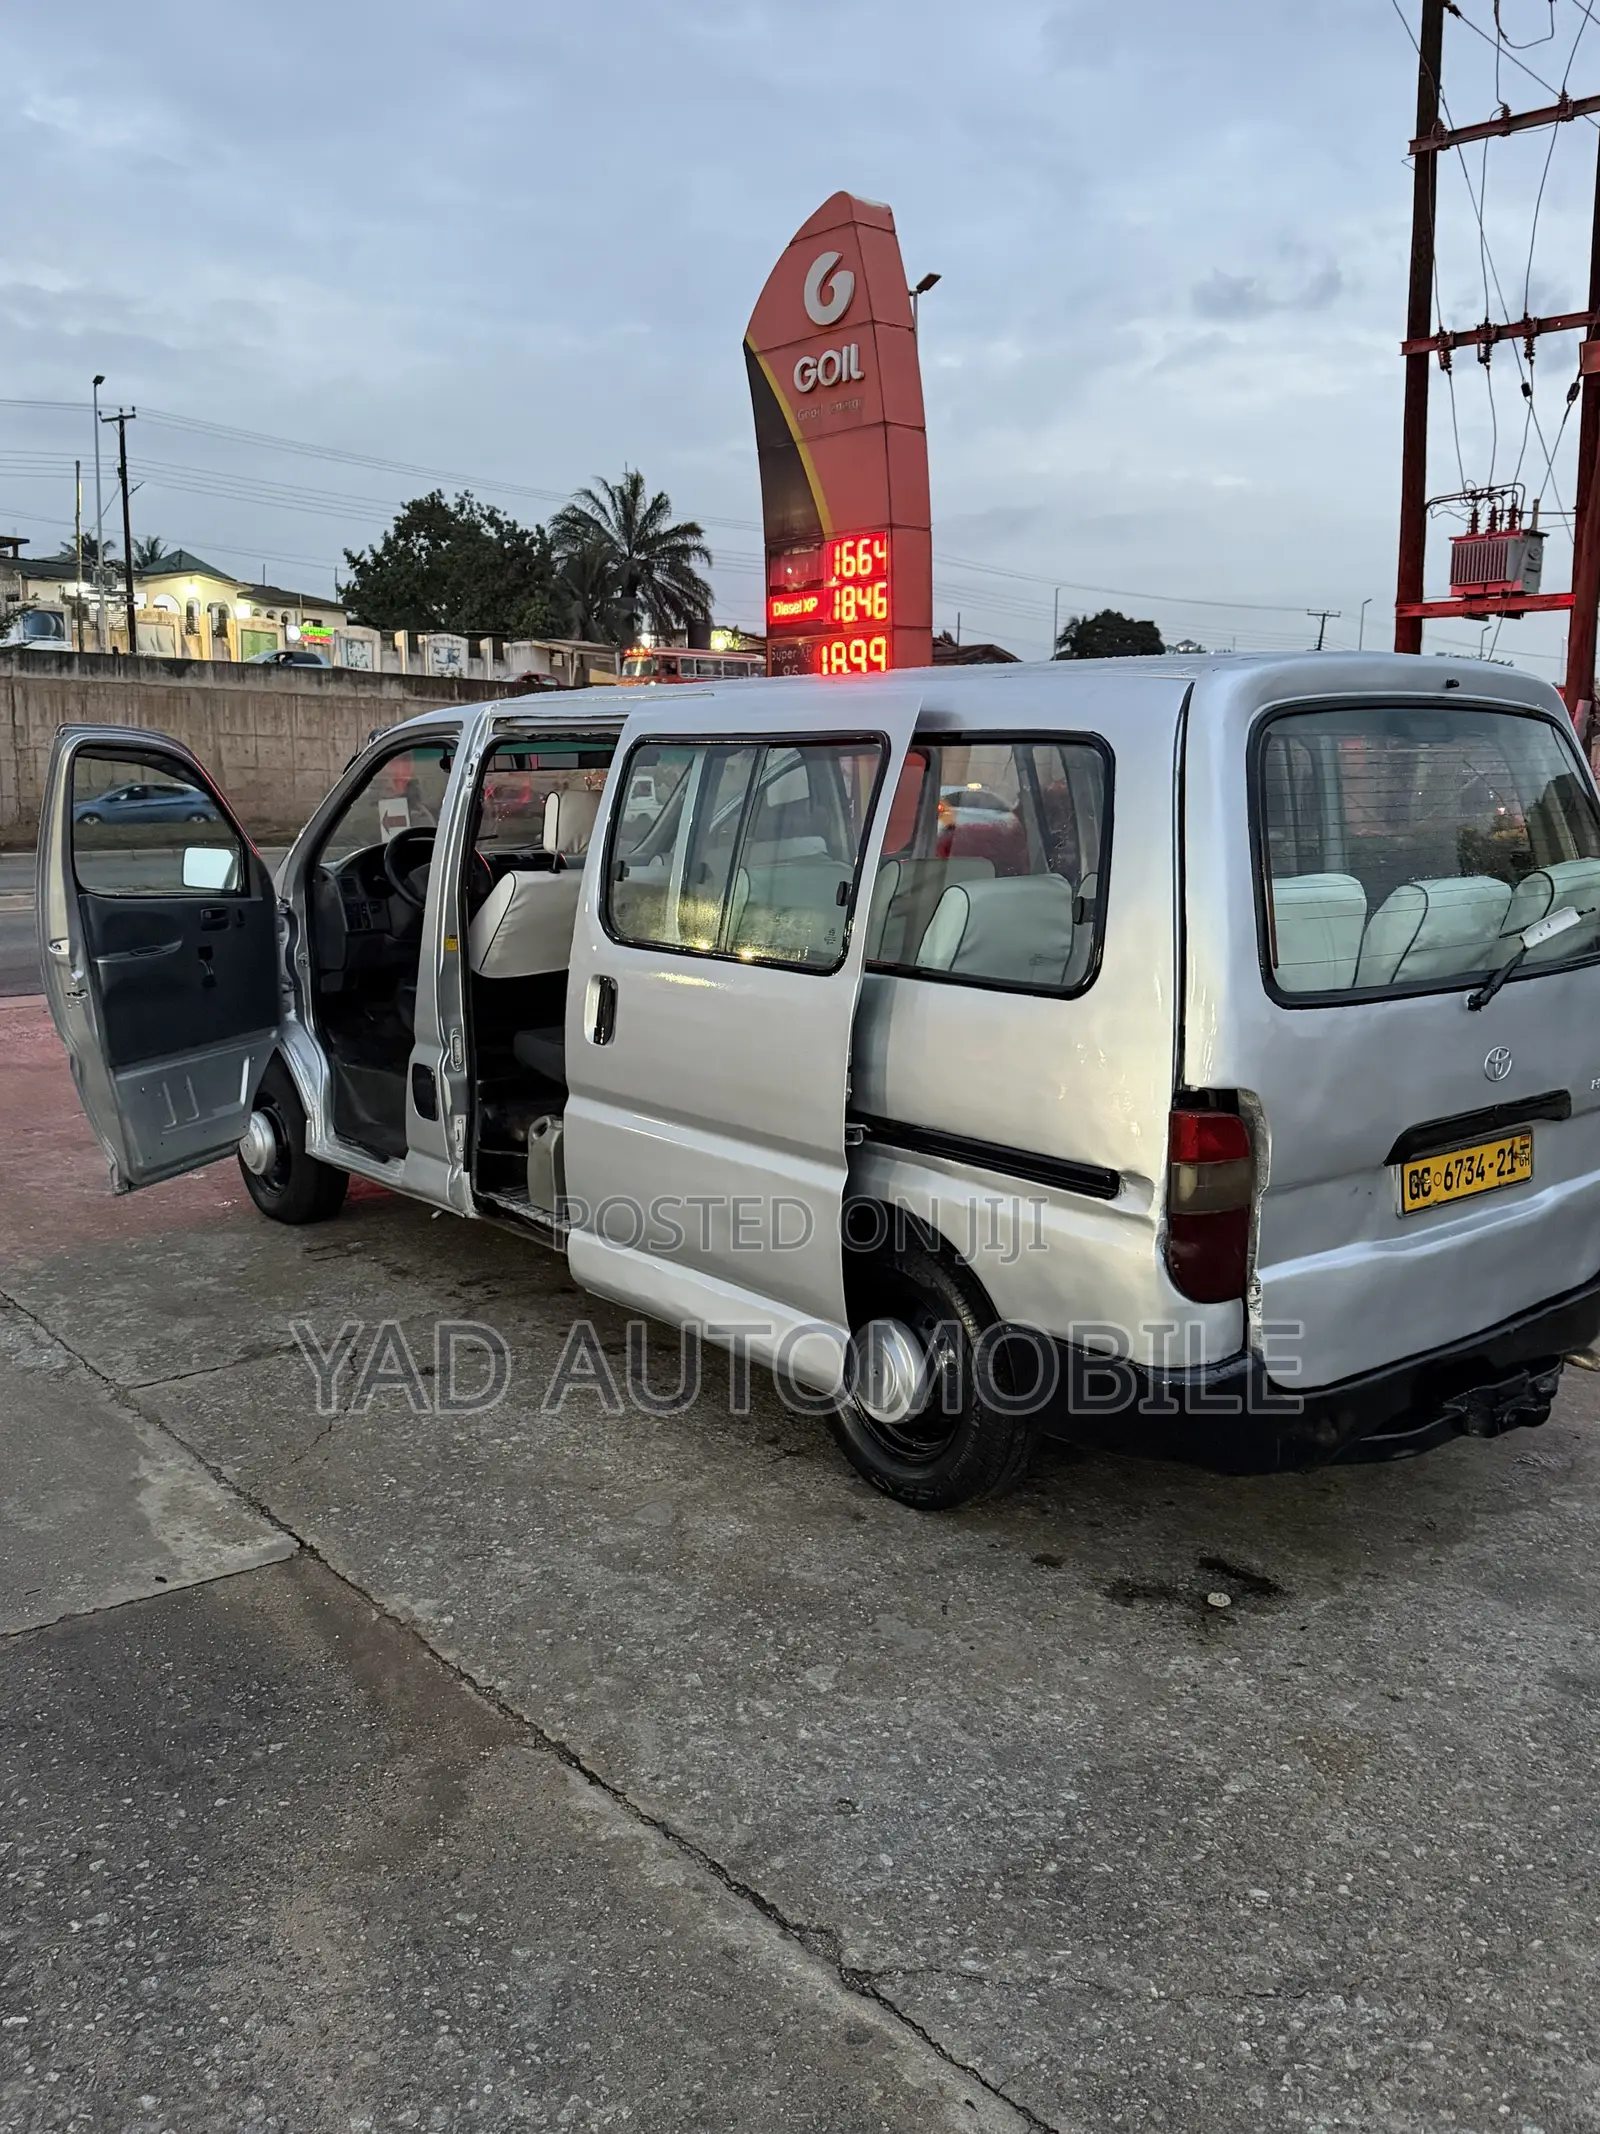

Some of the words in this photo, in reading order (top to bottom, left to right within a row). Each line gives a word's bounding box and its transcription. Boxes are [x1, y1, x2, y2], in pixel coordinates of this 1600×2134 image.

[793, 344, 865, 393] GOIL
[773, 599, 803, 617] Diesel
[803, 597, 818, 613] XP
[772, 647, 796, 663] Super
[801, 643, 813, 658] XP
